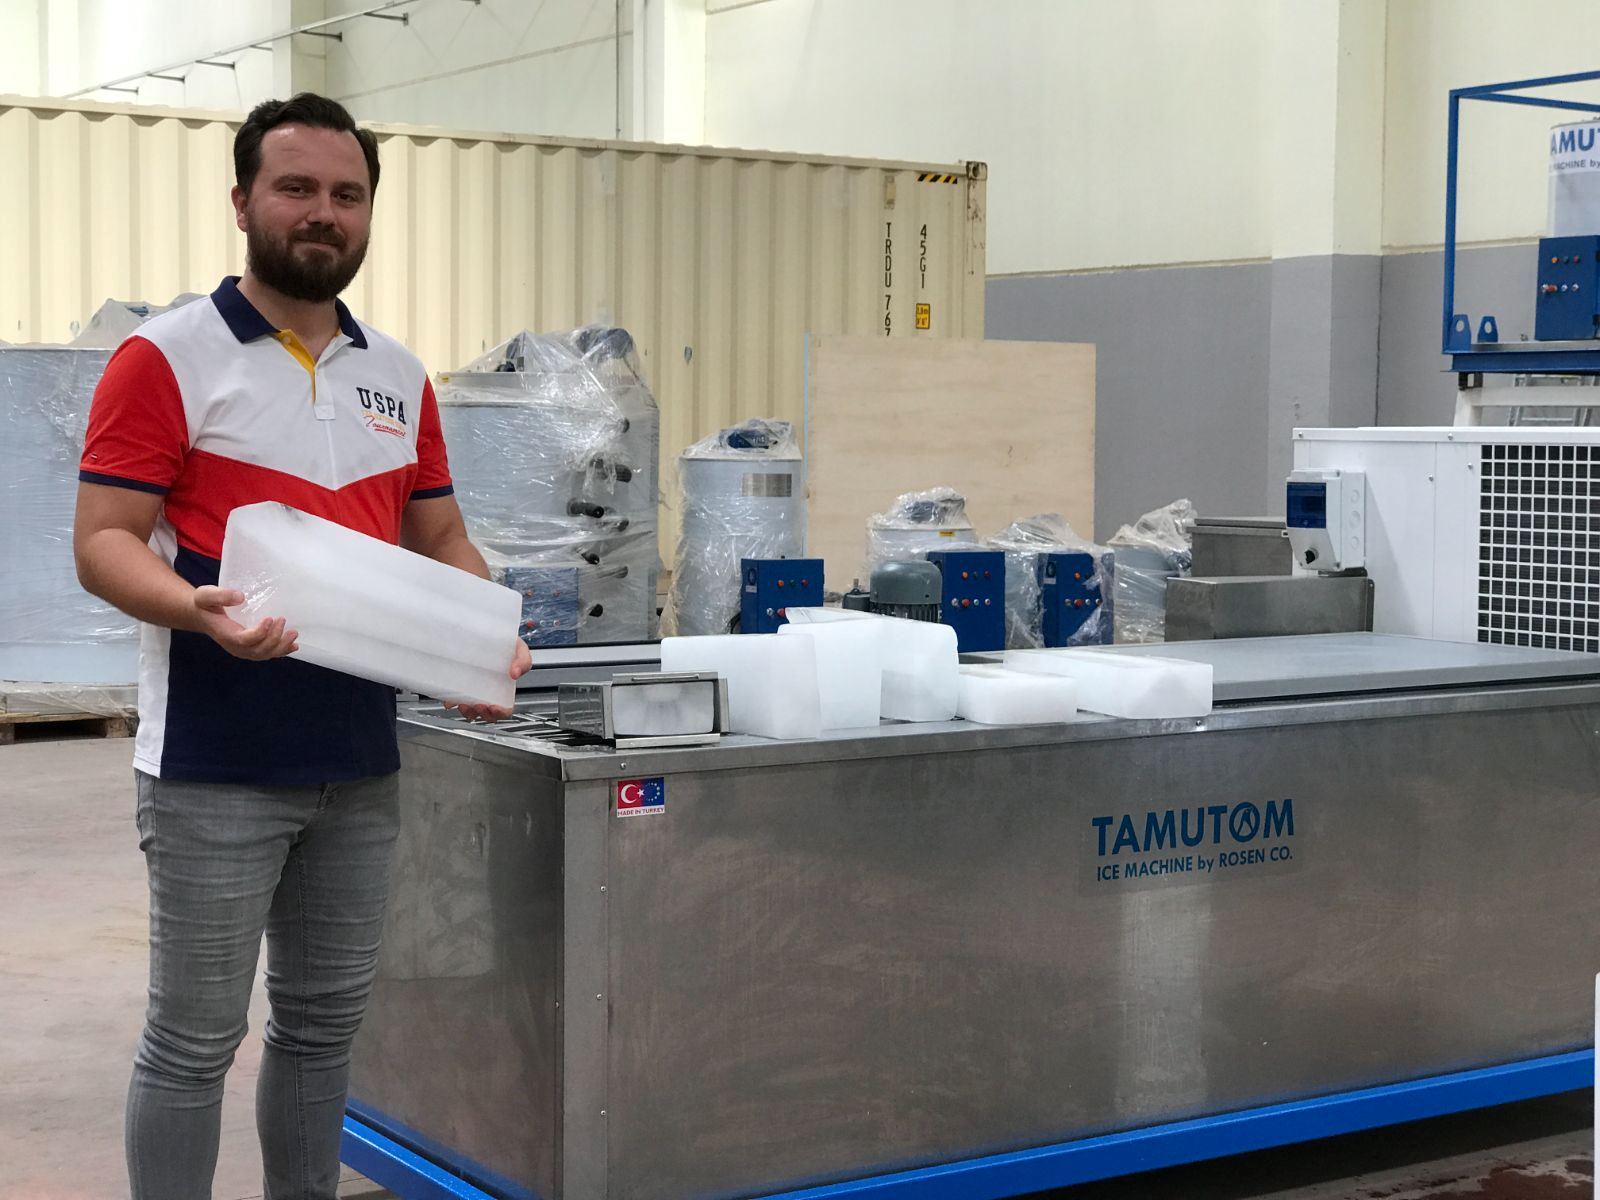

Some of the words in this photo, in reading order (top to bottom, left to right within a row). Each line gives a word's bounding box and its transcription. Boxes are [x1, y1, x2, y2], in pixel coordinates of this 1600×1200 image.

[1551, 128, 1600, 154] AMU
[884, 221, 892, 288] TRDU
[356, 386, 406, 425] USPA
[1091, 799, 1294, 857] TAMUTOM
[1097, 864, 1120, 882] ICE
[1124, 856, 1193, 879] MACHINE
[1197, 855, 1215, 874] by
[1219, 848, 1265, 868] ROSEN
[1270, 845, 1293, 862] CO.
